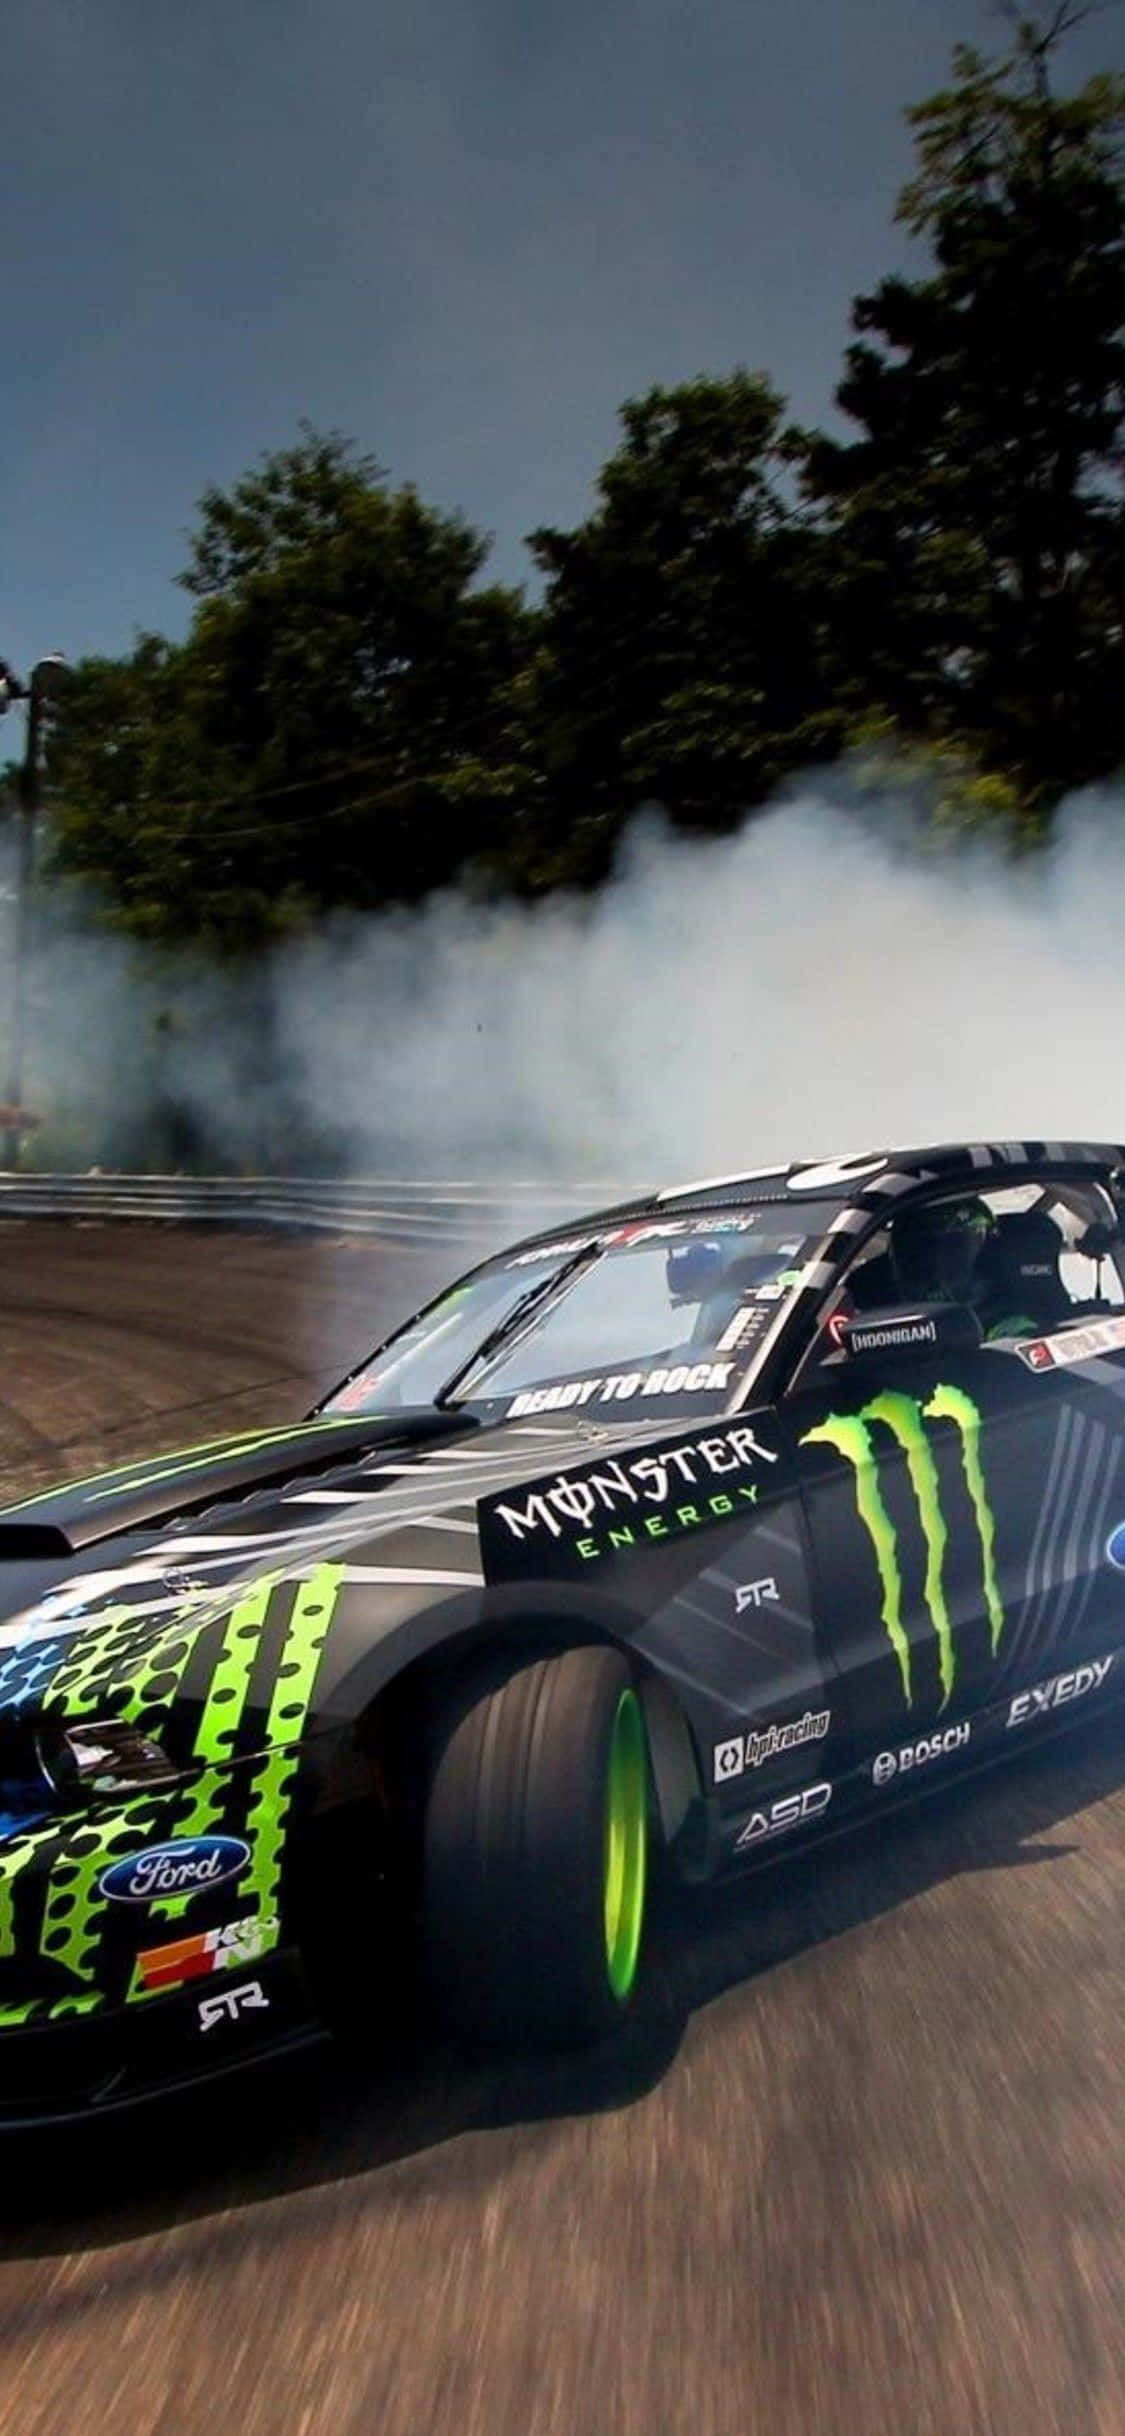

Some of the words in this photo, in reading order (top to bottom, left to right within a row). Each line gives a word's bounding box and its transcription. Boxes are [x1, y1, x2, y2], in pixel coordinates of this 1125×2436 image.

[505, 1379, 602, 1418] READY
[600, 1373, 643, 1402] TO
[642, 1362, 736, 1396] ROCK
[576, 1484, 761, 1560] ENERGY
[1006, 1655, 1114, 1728] EXEDY
[899, 1722, 971, 1773] BOSCH
[736, 1782, 833, 1845] ASD
[130, 1846, 222, 1895] Ford
